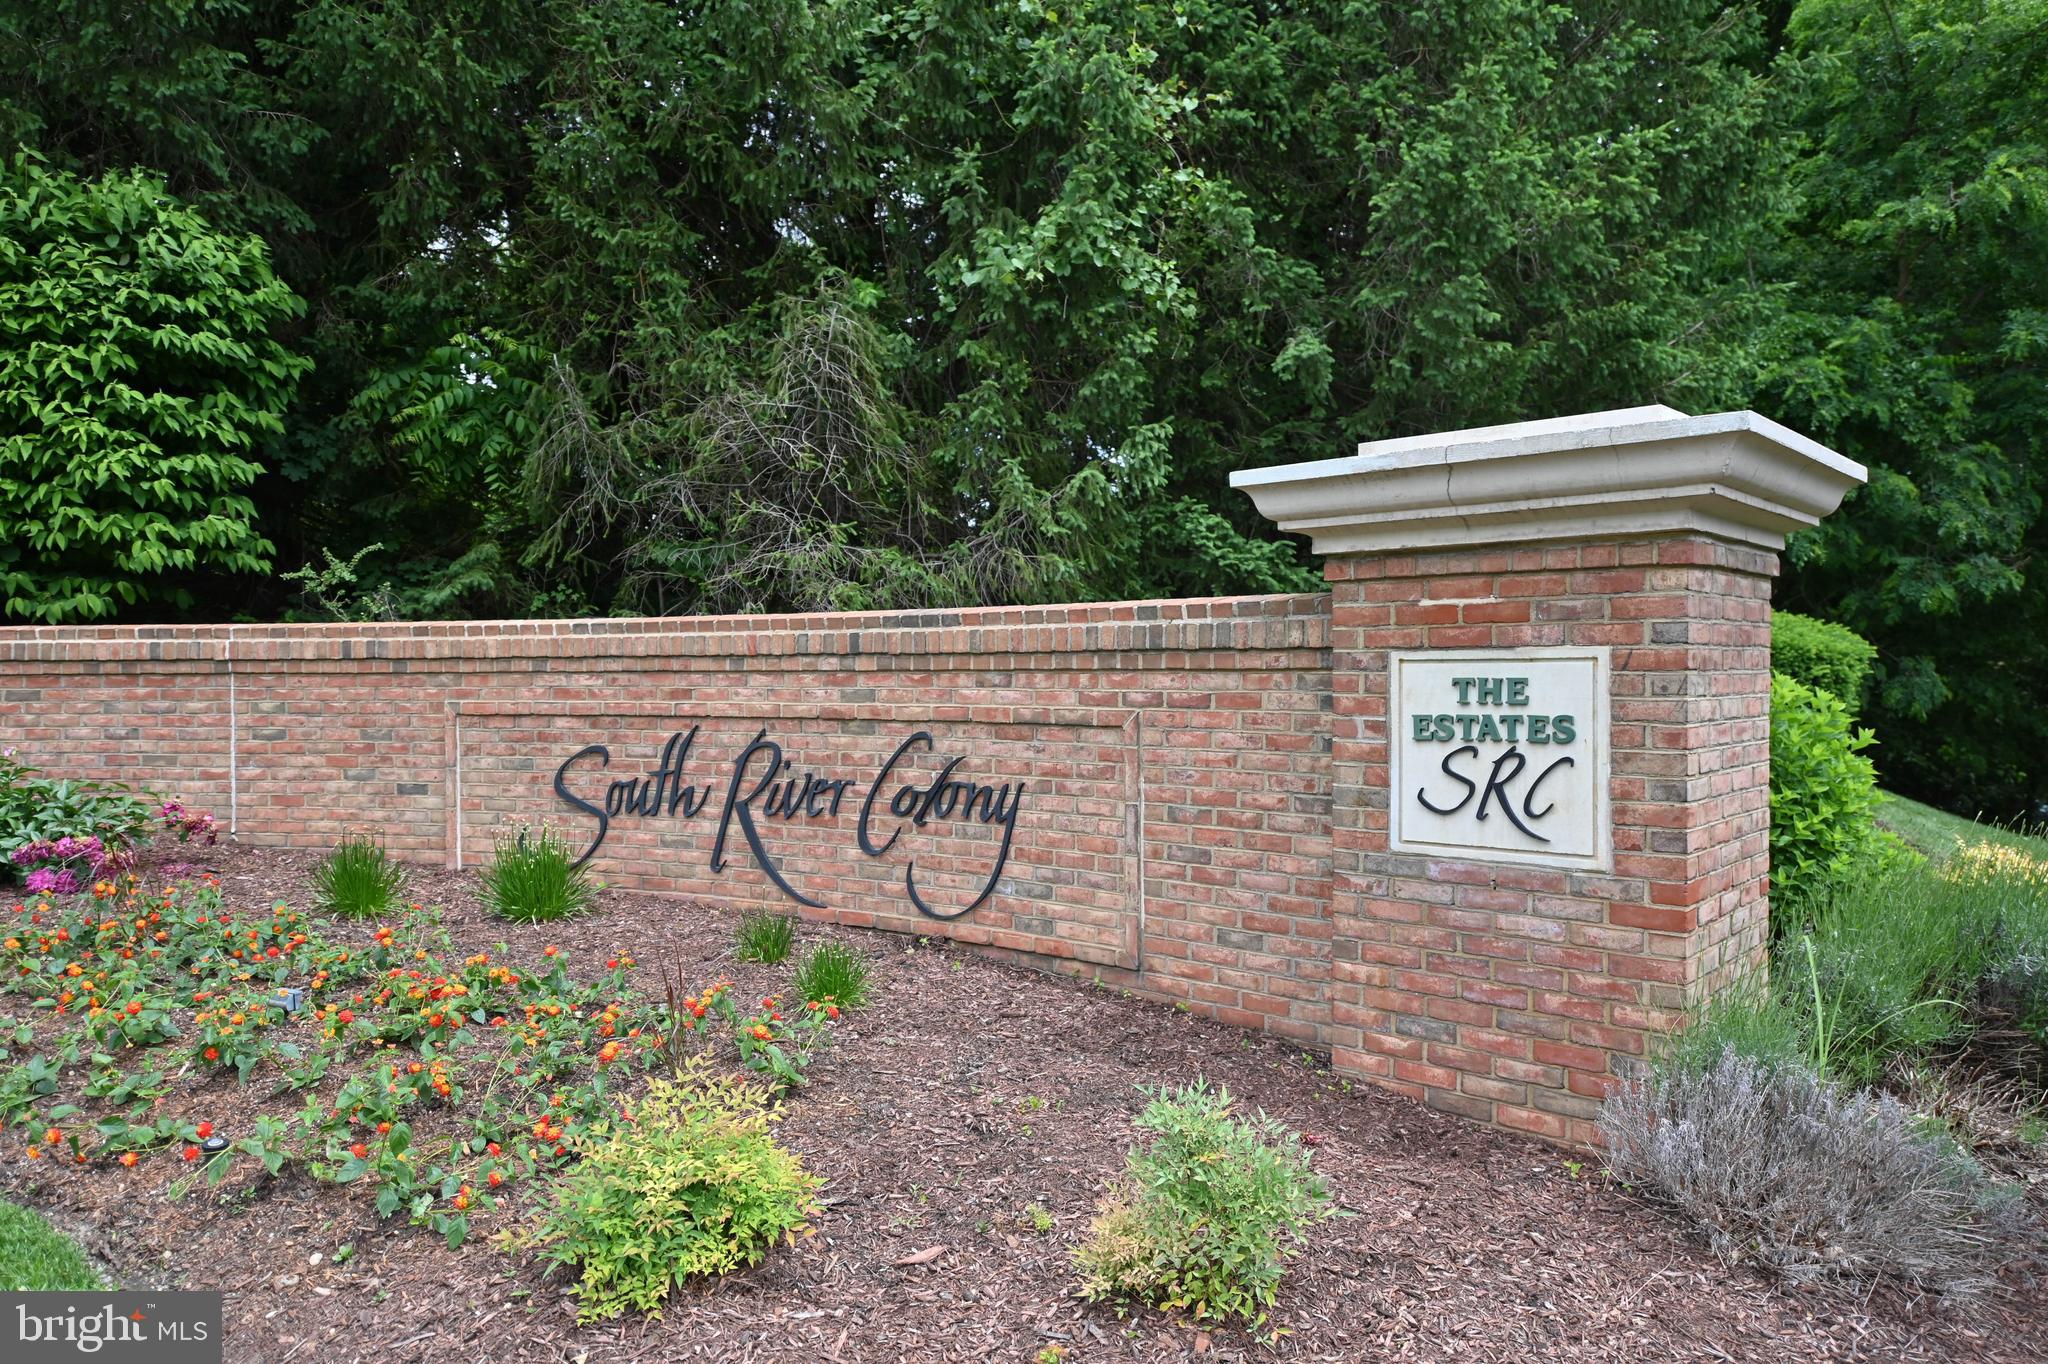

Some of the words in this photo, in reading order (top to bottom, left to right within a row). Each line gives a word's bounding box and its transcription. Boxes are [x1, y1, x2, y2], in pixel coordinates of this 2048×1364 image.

[1451, 677, 1530, 706] THE
[1411, 713, 1577, 745] ESTATES
[518, 725, 711, 871] South
[710, 728, 856, 908] River
[857, 731, 1026, 920] Colony
[1417, 745, 1575, 842] SRC
